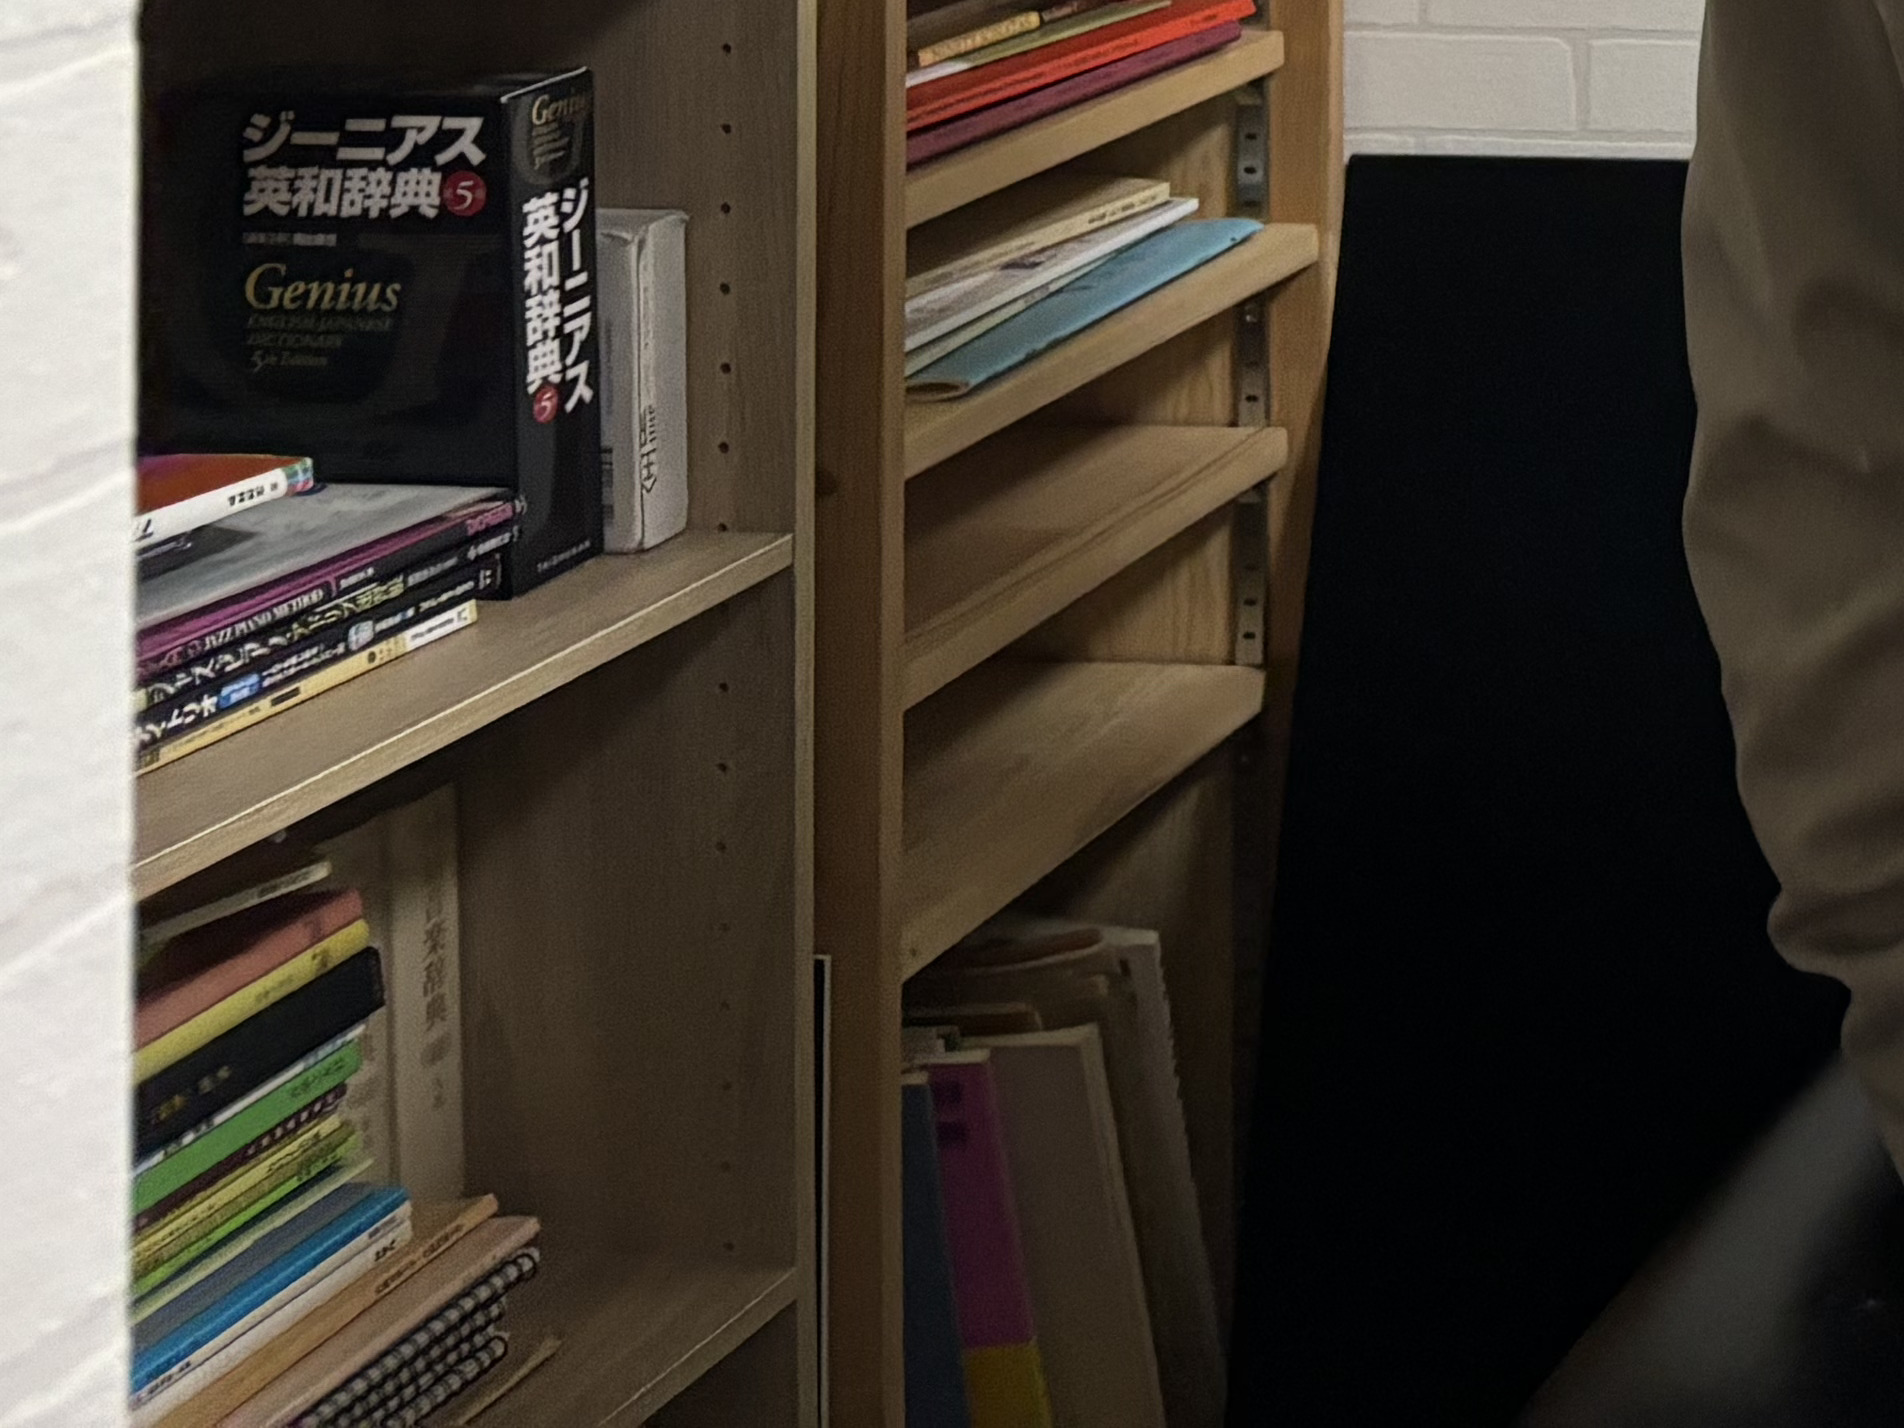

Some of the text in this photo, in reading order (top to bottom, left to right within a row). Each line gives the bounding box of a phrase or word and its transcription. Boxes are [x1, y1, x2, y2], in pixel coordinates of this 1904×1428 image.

[242, 110, 486, 166] ジーニアス
[242, 167, 443, 219] 英和辞典
[244, 262, 401, 313] Genius
[522, 191, 563, 396] 英和辞典
[562, 177, 594, 413] ジーニアス
